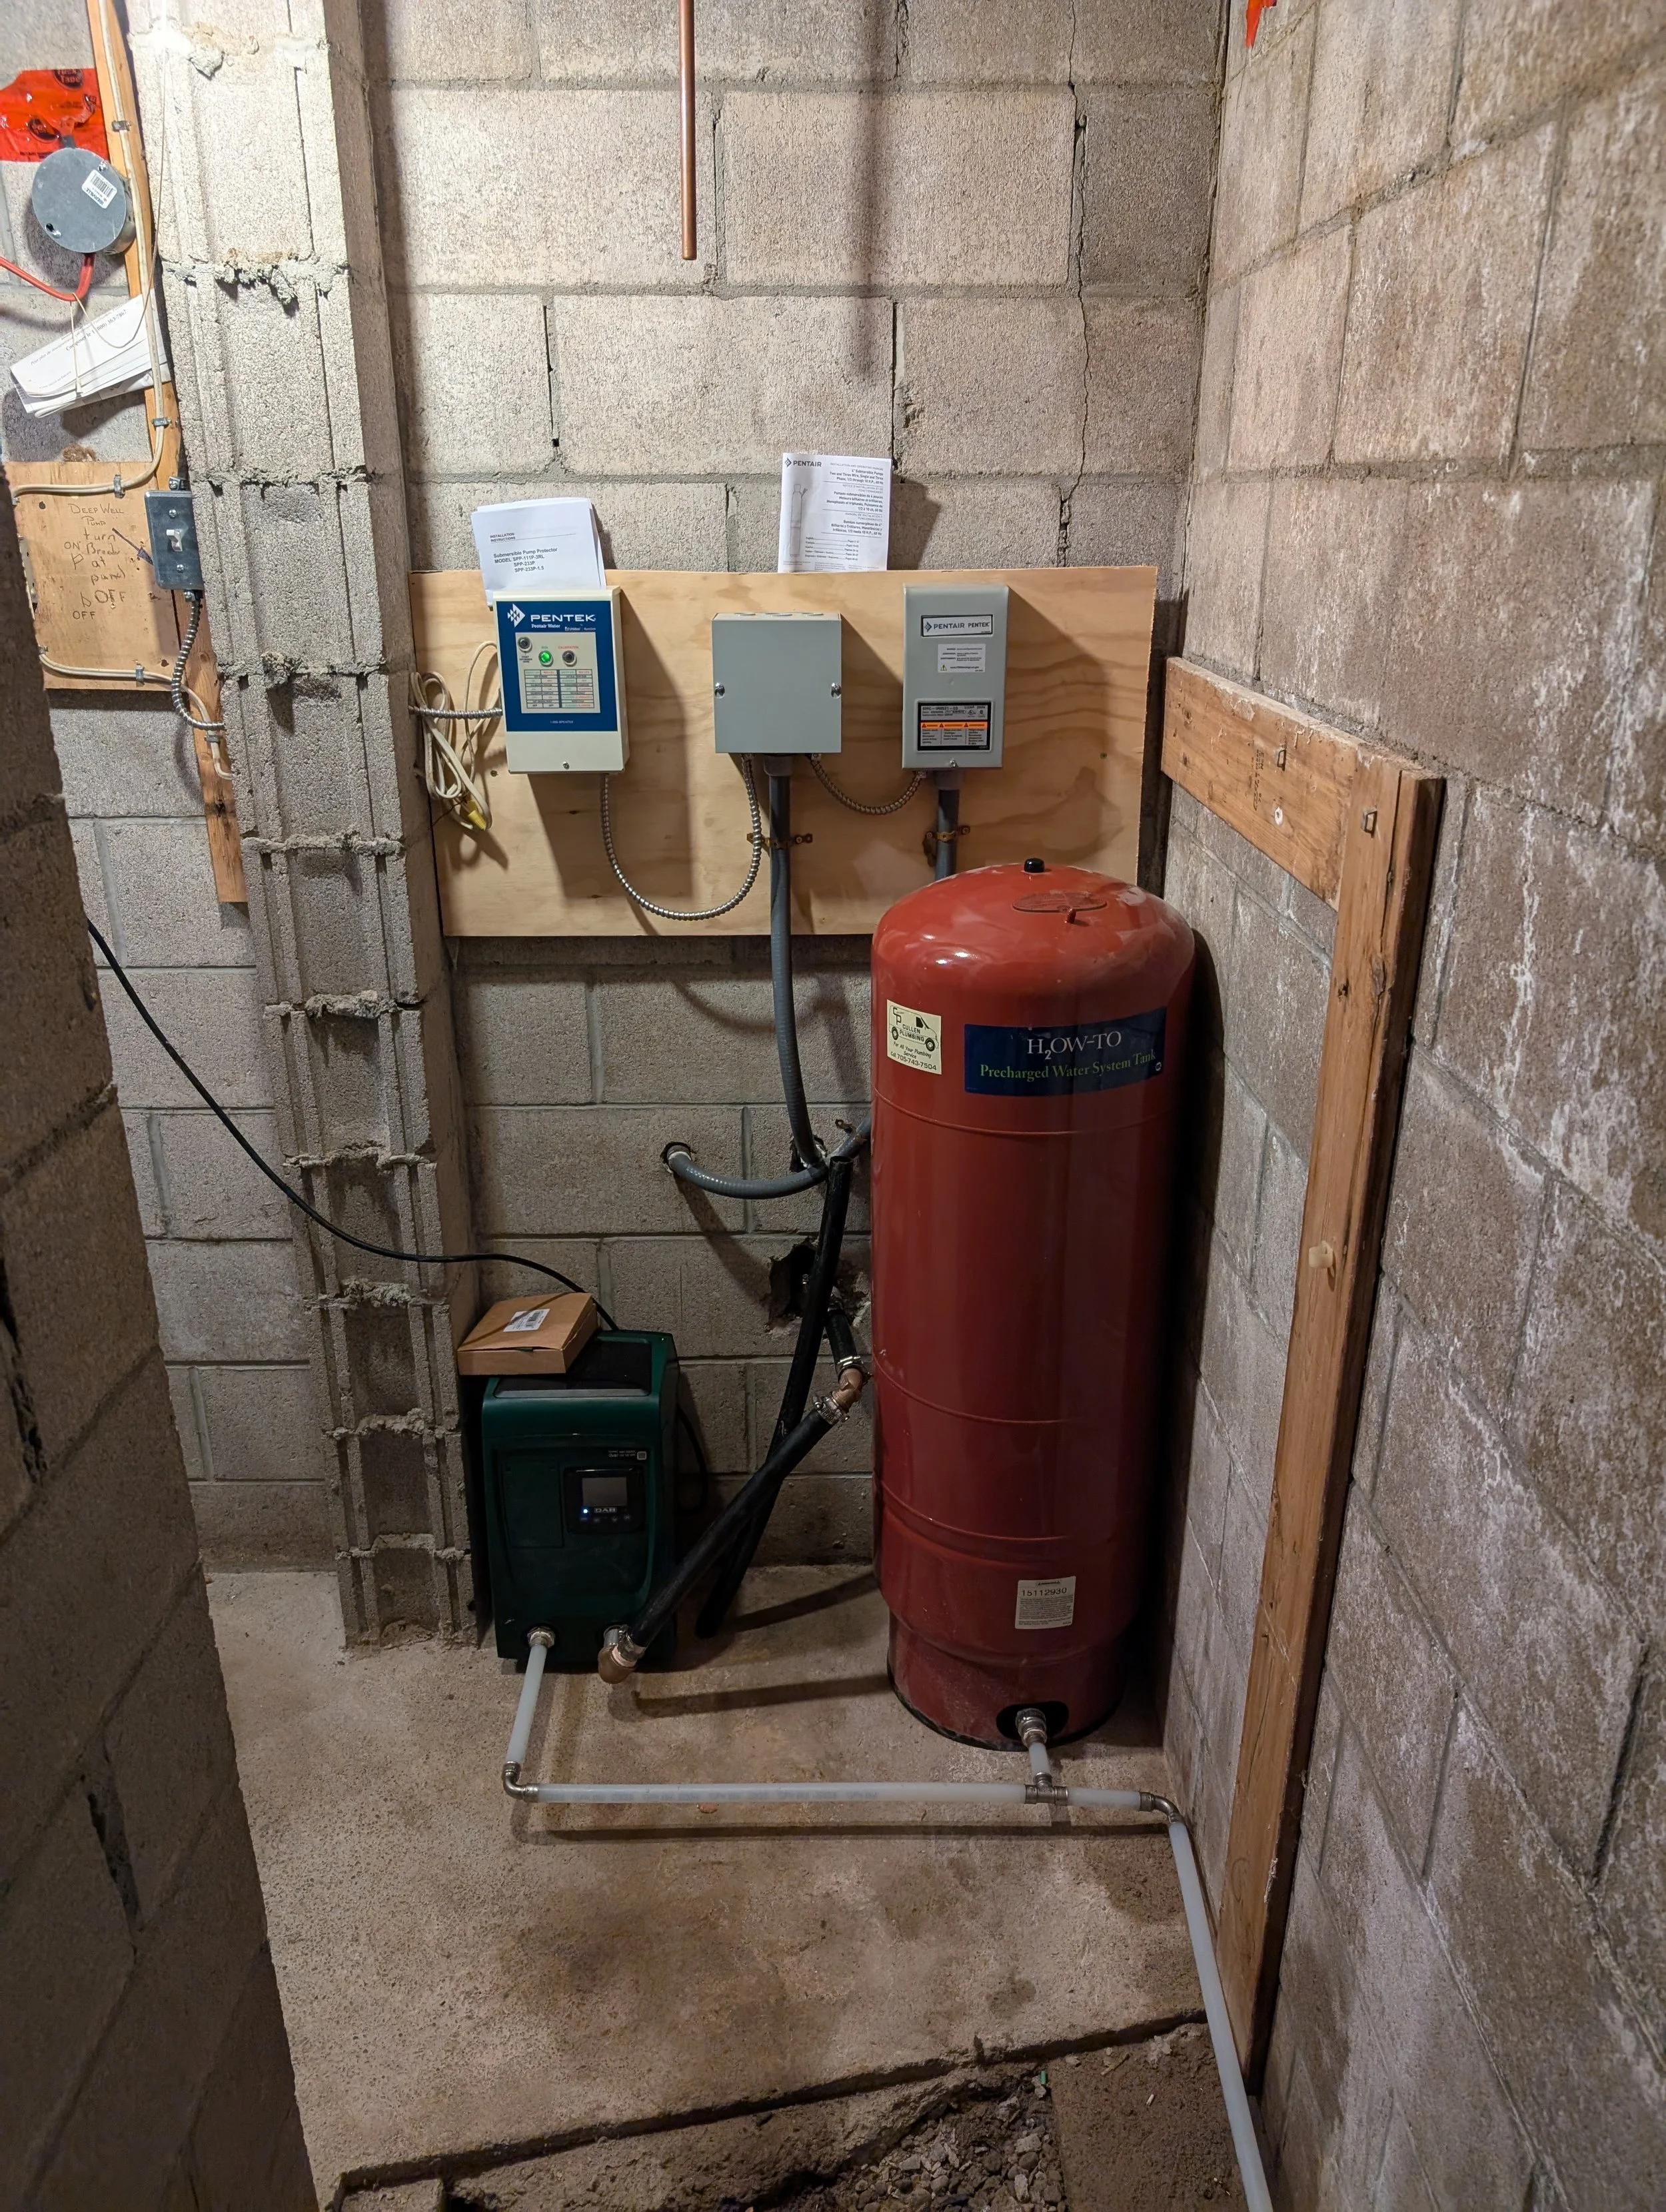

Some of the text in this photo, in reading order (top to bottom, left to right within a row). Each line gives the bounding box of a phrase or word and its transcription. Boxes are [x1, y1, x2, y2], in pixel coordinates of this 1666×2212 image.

[97, 322, 108, 332] 800)
[64, 541, 81, 550] ON
[94, 589, 127, 604] OFF
[72, 610, 96, 620] OFF
[902, 1023, 920, 1034] CULLEN
[899, 1030, 925, 1042] PLUMBING
[903, 1051, 917, 1059] Service
[914, 1048, 932, 1059] Plumbing
[897, 1053, 937, 1071] 705-743-7504
[980, 1049, 1157, 1082] Precharged Water System Tank
[1022, 1588, 1068, 1596] 15112930
